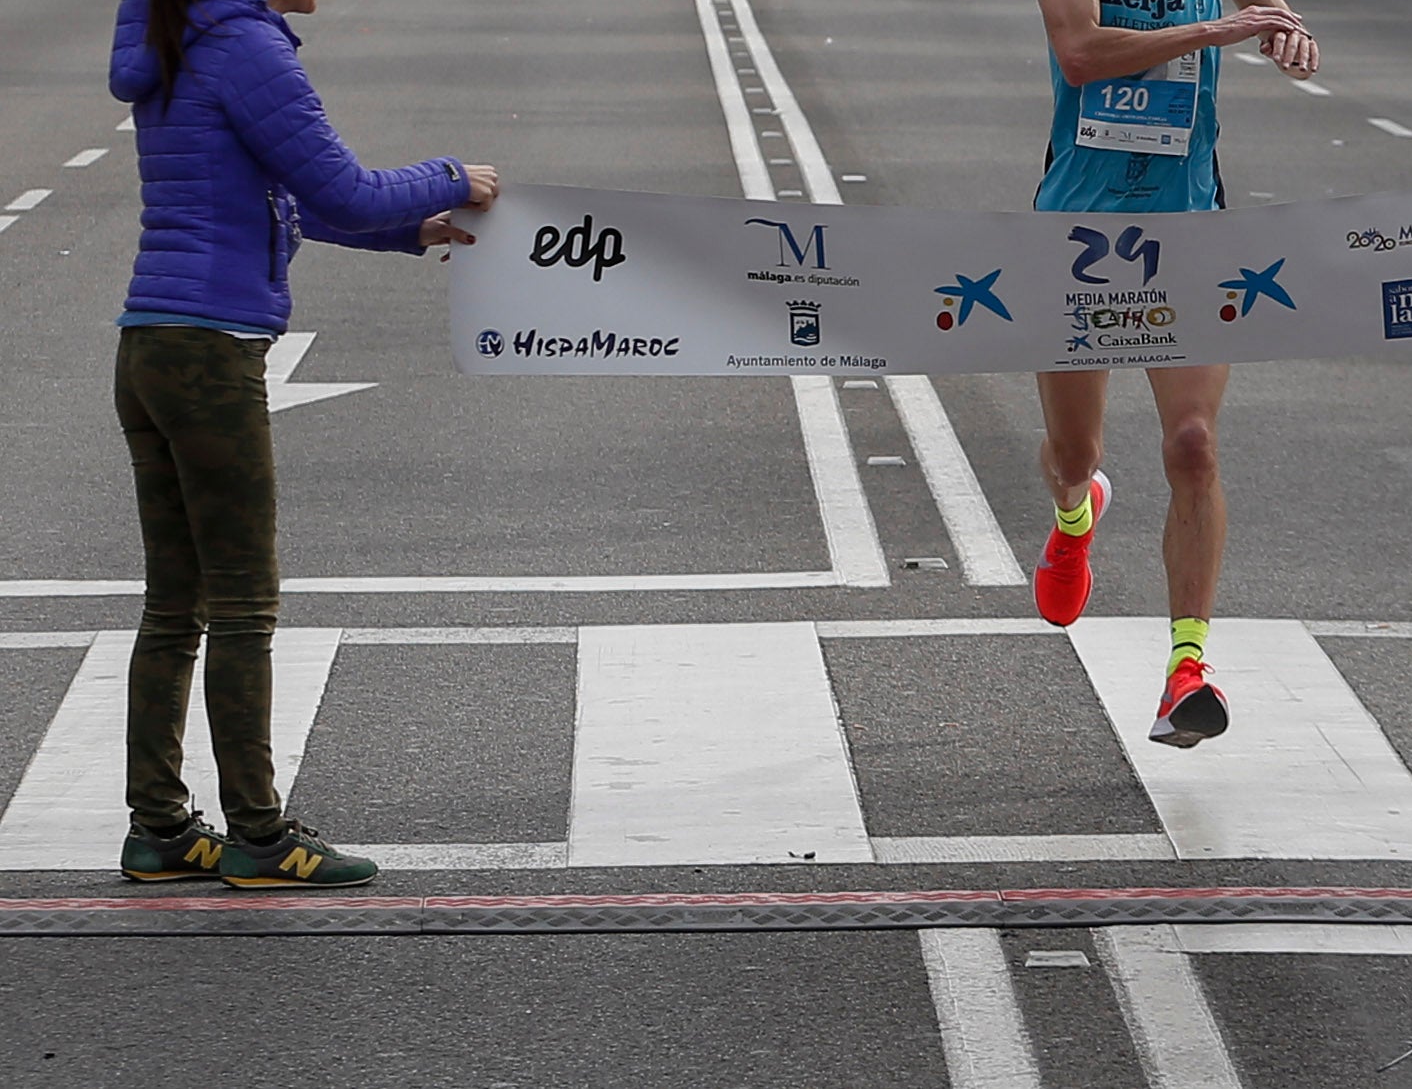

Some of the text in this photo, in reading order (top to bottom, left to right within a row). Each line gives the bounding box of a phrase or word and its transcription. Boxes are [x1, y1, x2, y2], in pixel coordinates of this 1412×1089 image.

[1101, 84, 1149, 112] 120
[529, 214, 626, 282] edp
[1067, 225, 1160, 287] 29
[808, 274, 860, 287] diputación
[1066, 289, 1167, 306] MEDIA MARATÓN
[1098, 333, 1177, 347] CaixaBank
[727, 355, 887, 370] Ayuntamiento de Málaga
[1071, 357, 1109, 366] CIUDAD
[1127, 354, 1171, 364] MÁLAGA
[278, 846, 323, 878] N
